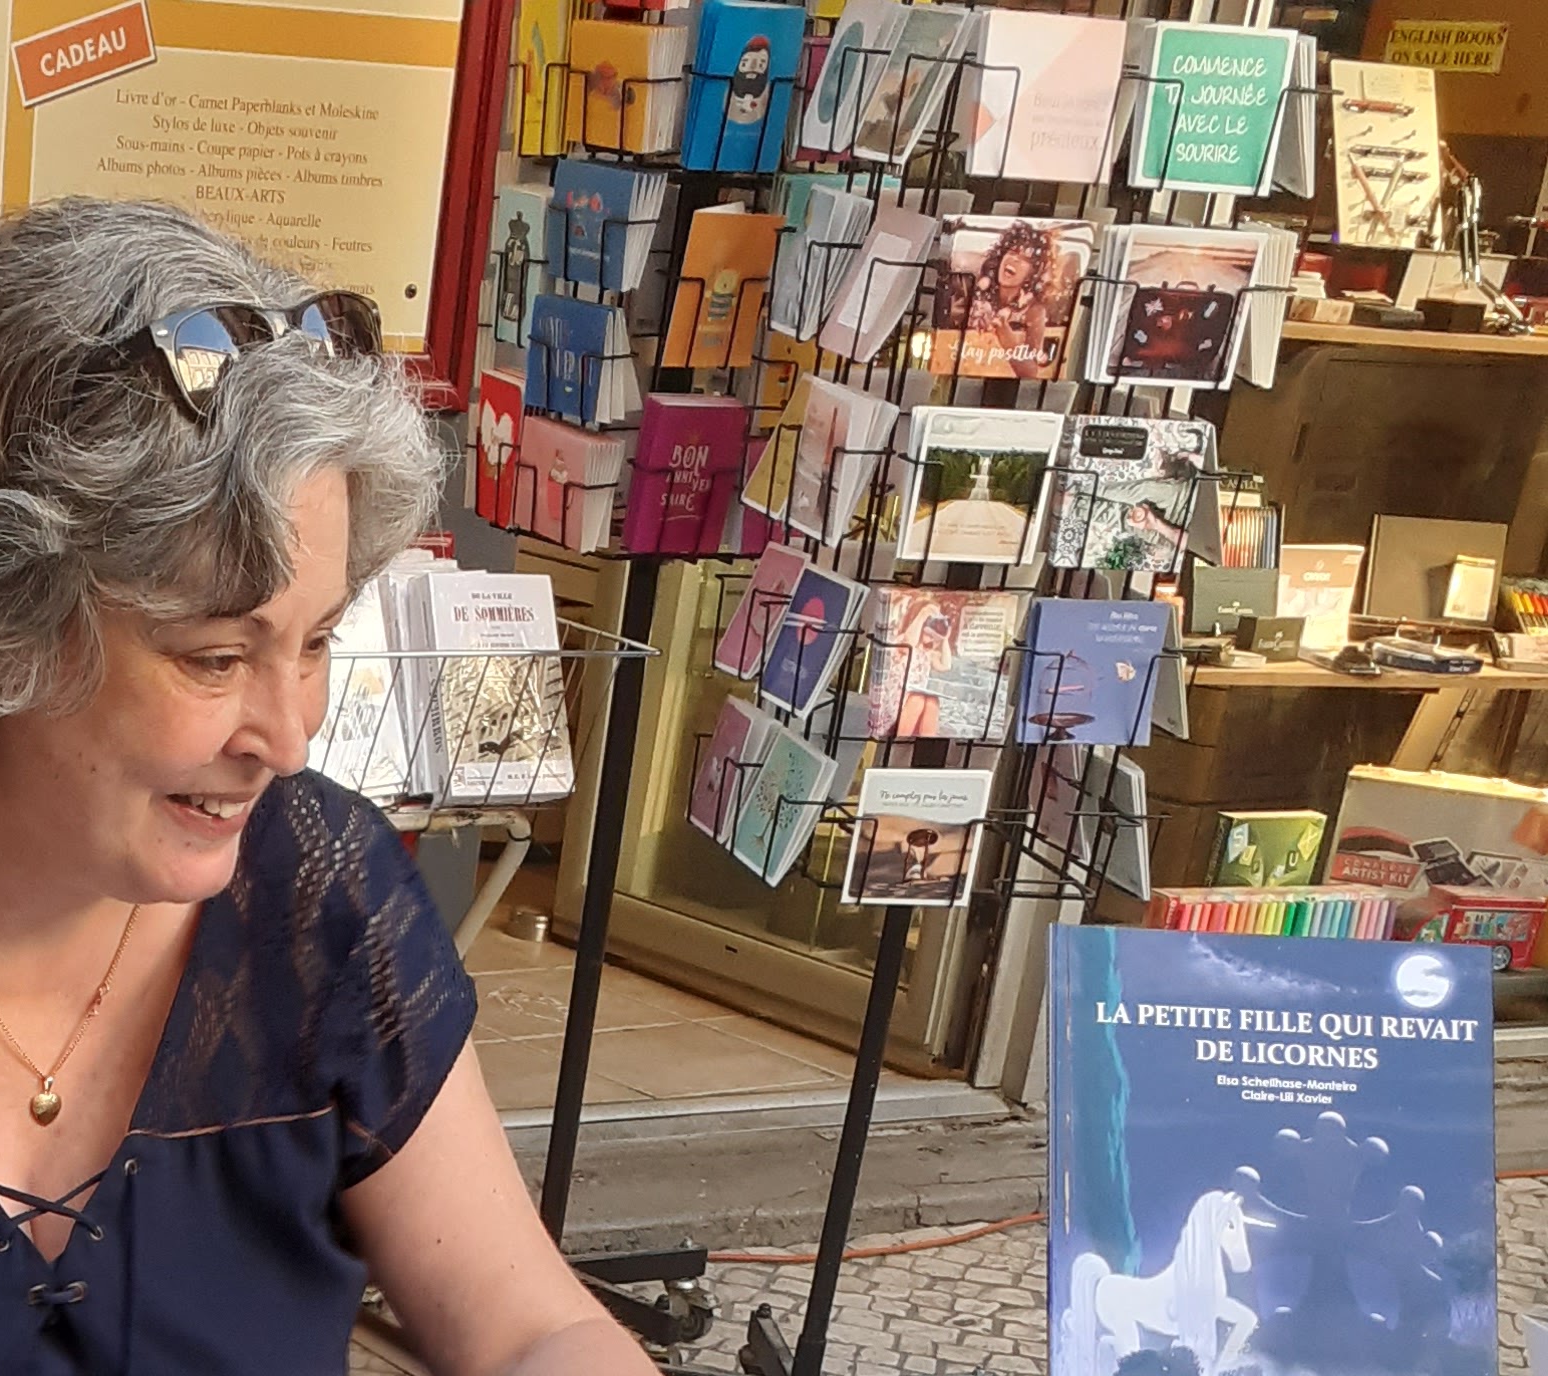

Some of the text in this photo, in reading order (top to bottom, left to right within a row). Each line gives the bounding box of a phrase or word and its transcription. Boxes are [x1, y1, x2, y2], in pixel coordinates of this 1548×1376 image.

[1390, 29, 1504, 45] ENGLISH BOOKS
[40, 26, 127, 77] CADEAU
[116, 89, 379, 121] Livre d'or Carnet Paperblanks et Moleskine
[1191, 83, 1268, 106] JOURNÉE
[152, 115, 339, 140] Stylos de luxe Objets souvenir
[1175, 114, 1249, 135] AVEC LE
[116, 135, 368, 167] Sous-mains Coupe papier Pots à crayons
[1176, 143, 1240, 163] SOURIRE
[96, 157, 384, 188] Albums photos Albums pièces Albums timbres
[196, 186, 286, 203] BEAUX-ARTS
[266, 211, 322, 229] Aquarelle
[272, 236, 374, 253] couleurs Feutres
[988, 342, 1047, 365] positive
[669, 444, 709, 476] BON
[453, 603, 535, 622] DE SOMMIÈRES
[1342, 866, 1412, 885] ARTIST KIT
[1095, 1002, 1480, 1042] LA PETITE FILLE QUI REVAIT
[1195, 1039, 1380, 1070] DE LICORNES
[1216, 1074, 1358, 1093] Elsa Schellhase-Monteiro
[1296, 1091, 1333, 1104] Xavier
